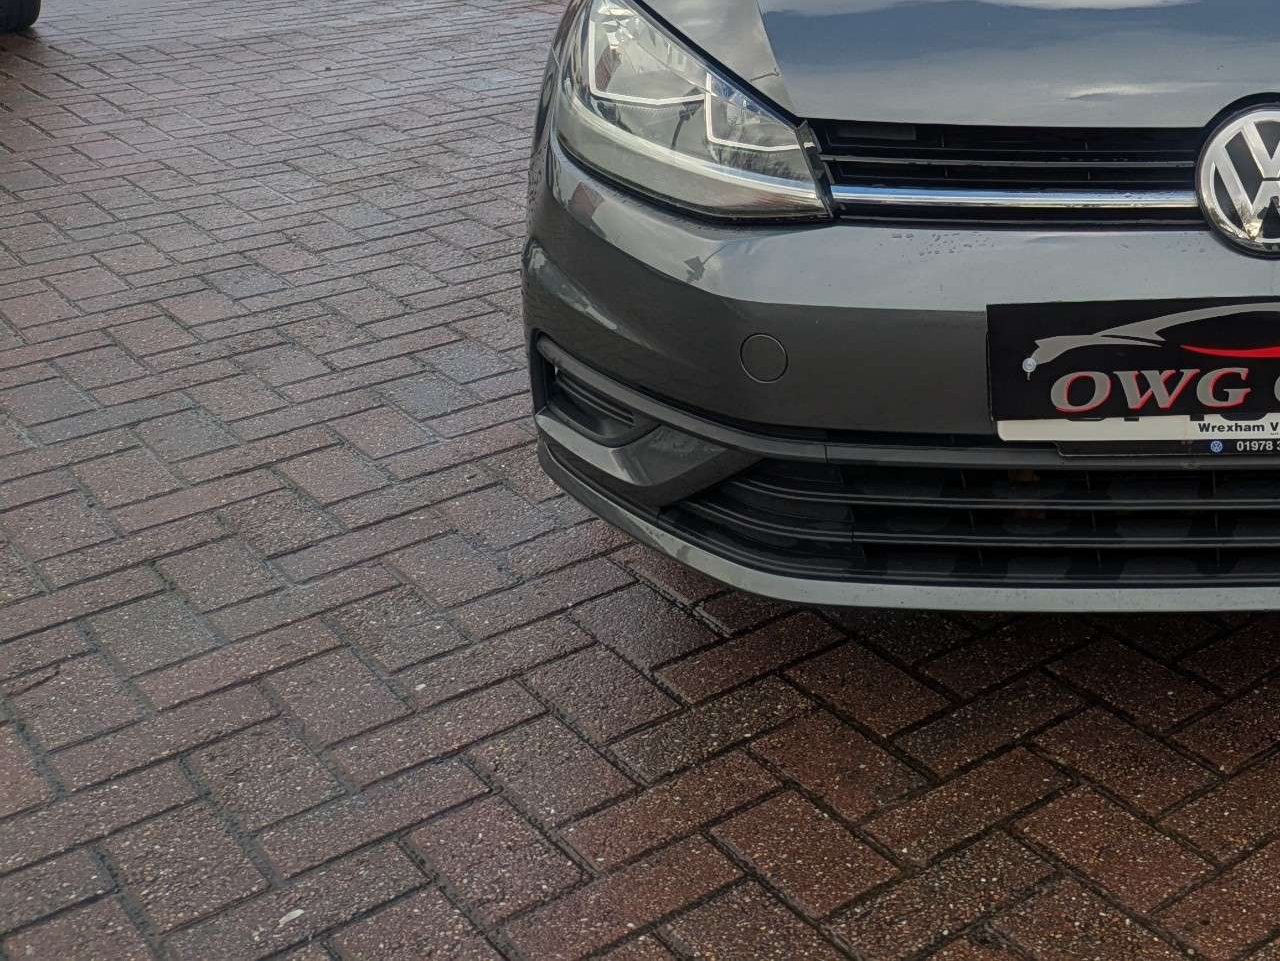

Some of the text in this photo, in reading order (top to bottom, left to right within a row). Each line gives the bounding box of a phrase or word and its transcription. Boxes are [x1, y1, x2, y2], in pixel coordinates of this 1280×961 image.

[1050, 365, 1252, 413] OWG
[1197, 422, 1266, 433] Wrexham
[1236, 439, 1274, 452] 01978
